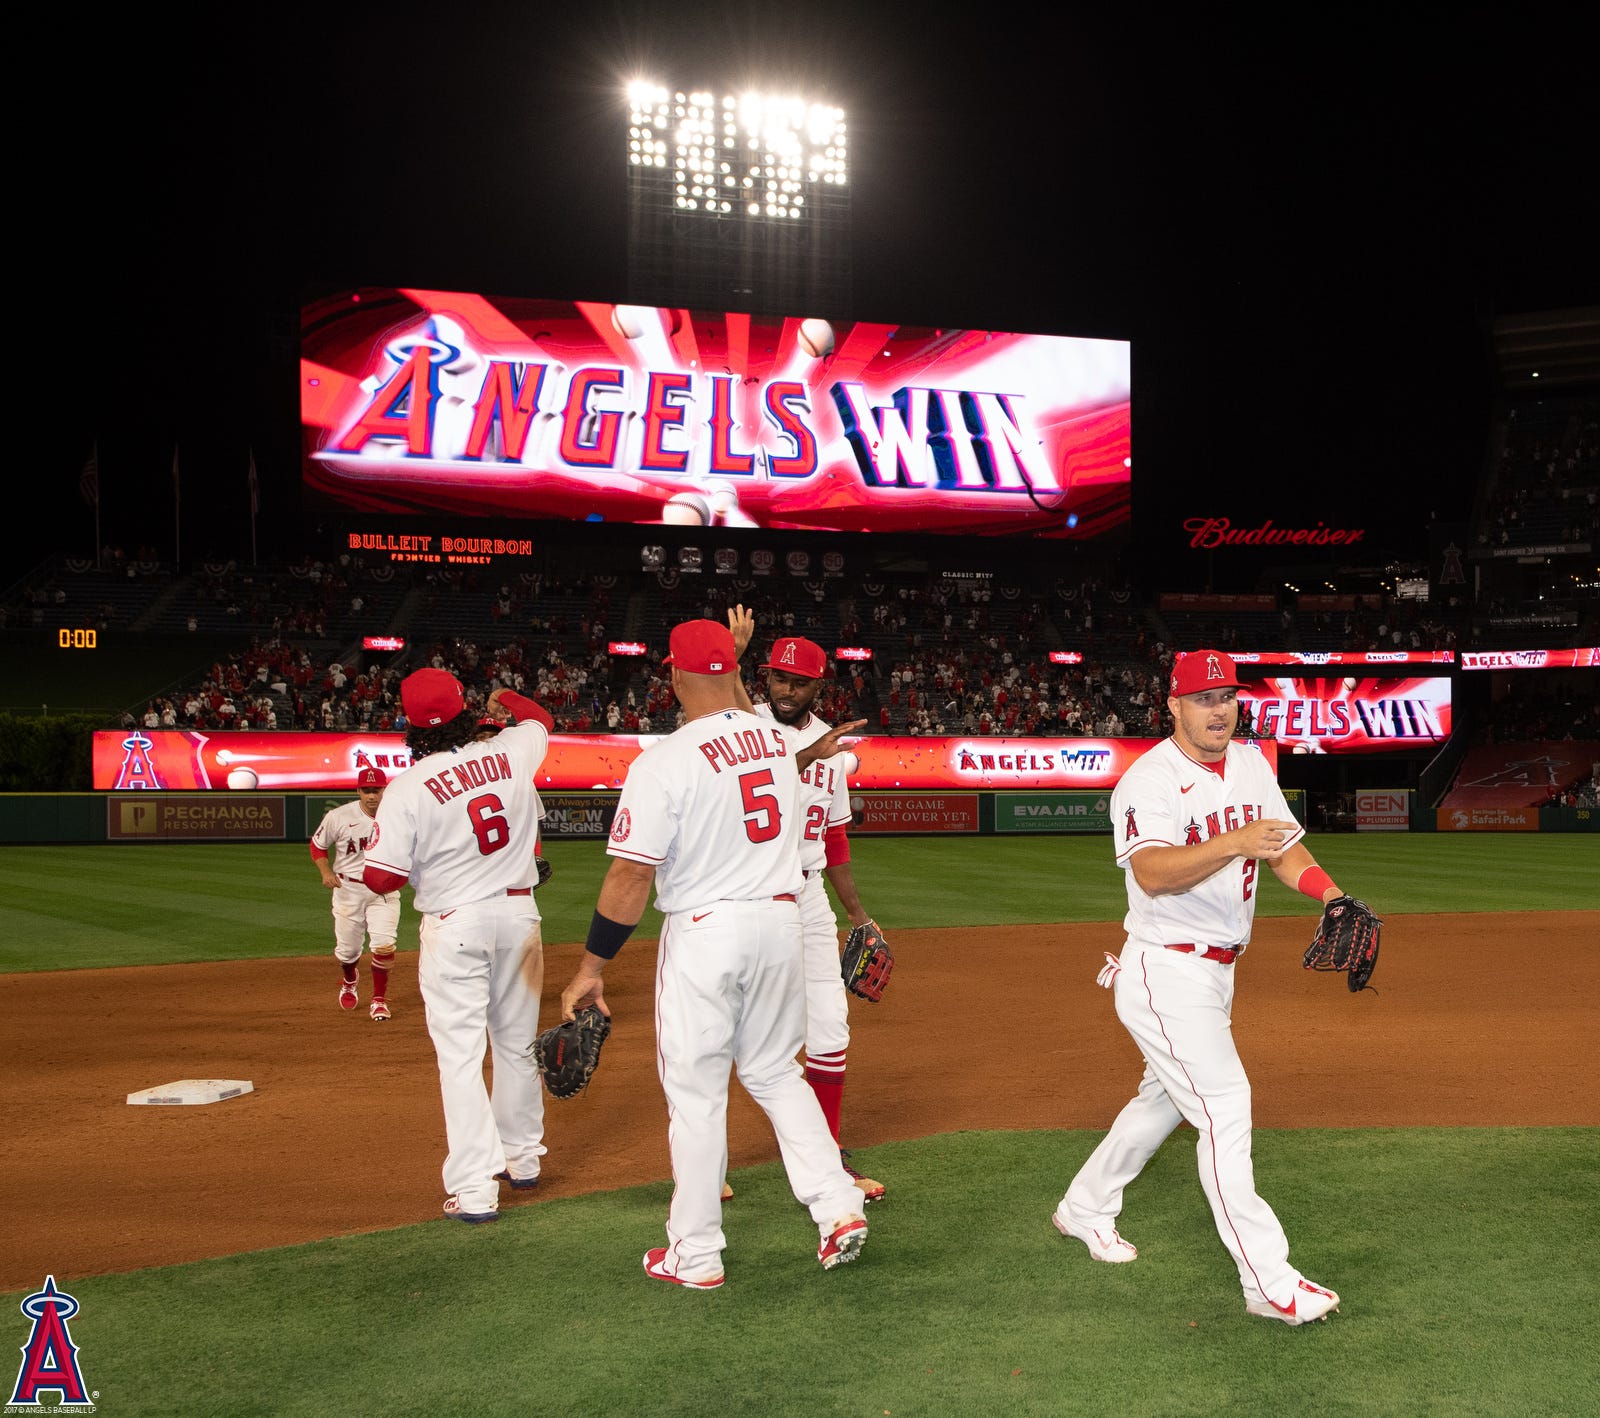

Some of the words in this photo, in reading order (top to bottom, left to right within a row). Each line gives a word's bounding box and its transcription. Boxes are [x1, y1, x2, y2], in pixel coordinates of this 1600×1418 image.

[312, 317, 820, 478] ANGELS
[830, 381, 1063, 494] WIN
[1182, 517, 1366, 549] Budweiser
[349, 533, 432, 551] BULLEIT
[441, 537, 532, 555] BOURBON
[447, 555, 492, 565] WHISKEY
[59, 629, 97, 648] 0:00
[1355, 700, 1444, 737] WIN
[699, 728, 787, 773] PUJOLS
[957, 748, 1054, 771] ANGELS
[1061, 750, 1111, 771] WIN
[424, 753, 513, 805] RENDON
[558, 798, 590, 808] Always
[738, 768, 782, 844] 5
[866, 800, 903, 809] YOUR
[906, 800, 945, 809] GAME
[1357, 795, 1405, 812] GEN
[164, 806, 272, 819] PECHANGA
[867, 812, 898, 822] ISN'T
[902, 812, 938, 821] OVER
[1366, 816, 1406, 824] PLUMBING
[1471, 815, 1501, 825] Safari
[1503, 815, 1527, 825] Park
[1576, 810, 1591, 820] 350
[164, 821, 216, 830] RESORT
[224, 820, 273, 830] CASINO
[467, 793, 511, 856] 6
[560, 823, 604, 832] SIGNS
